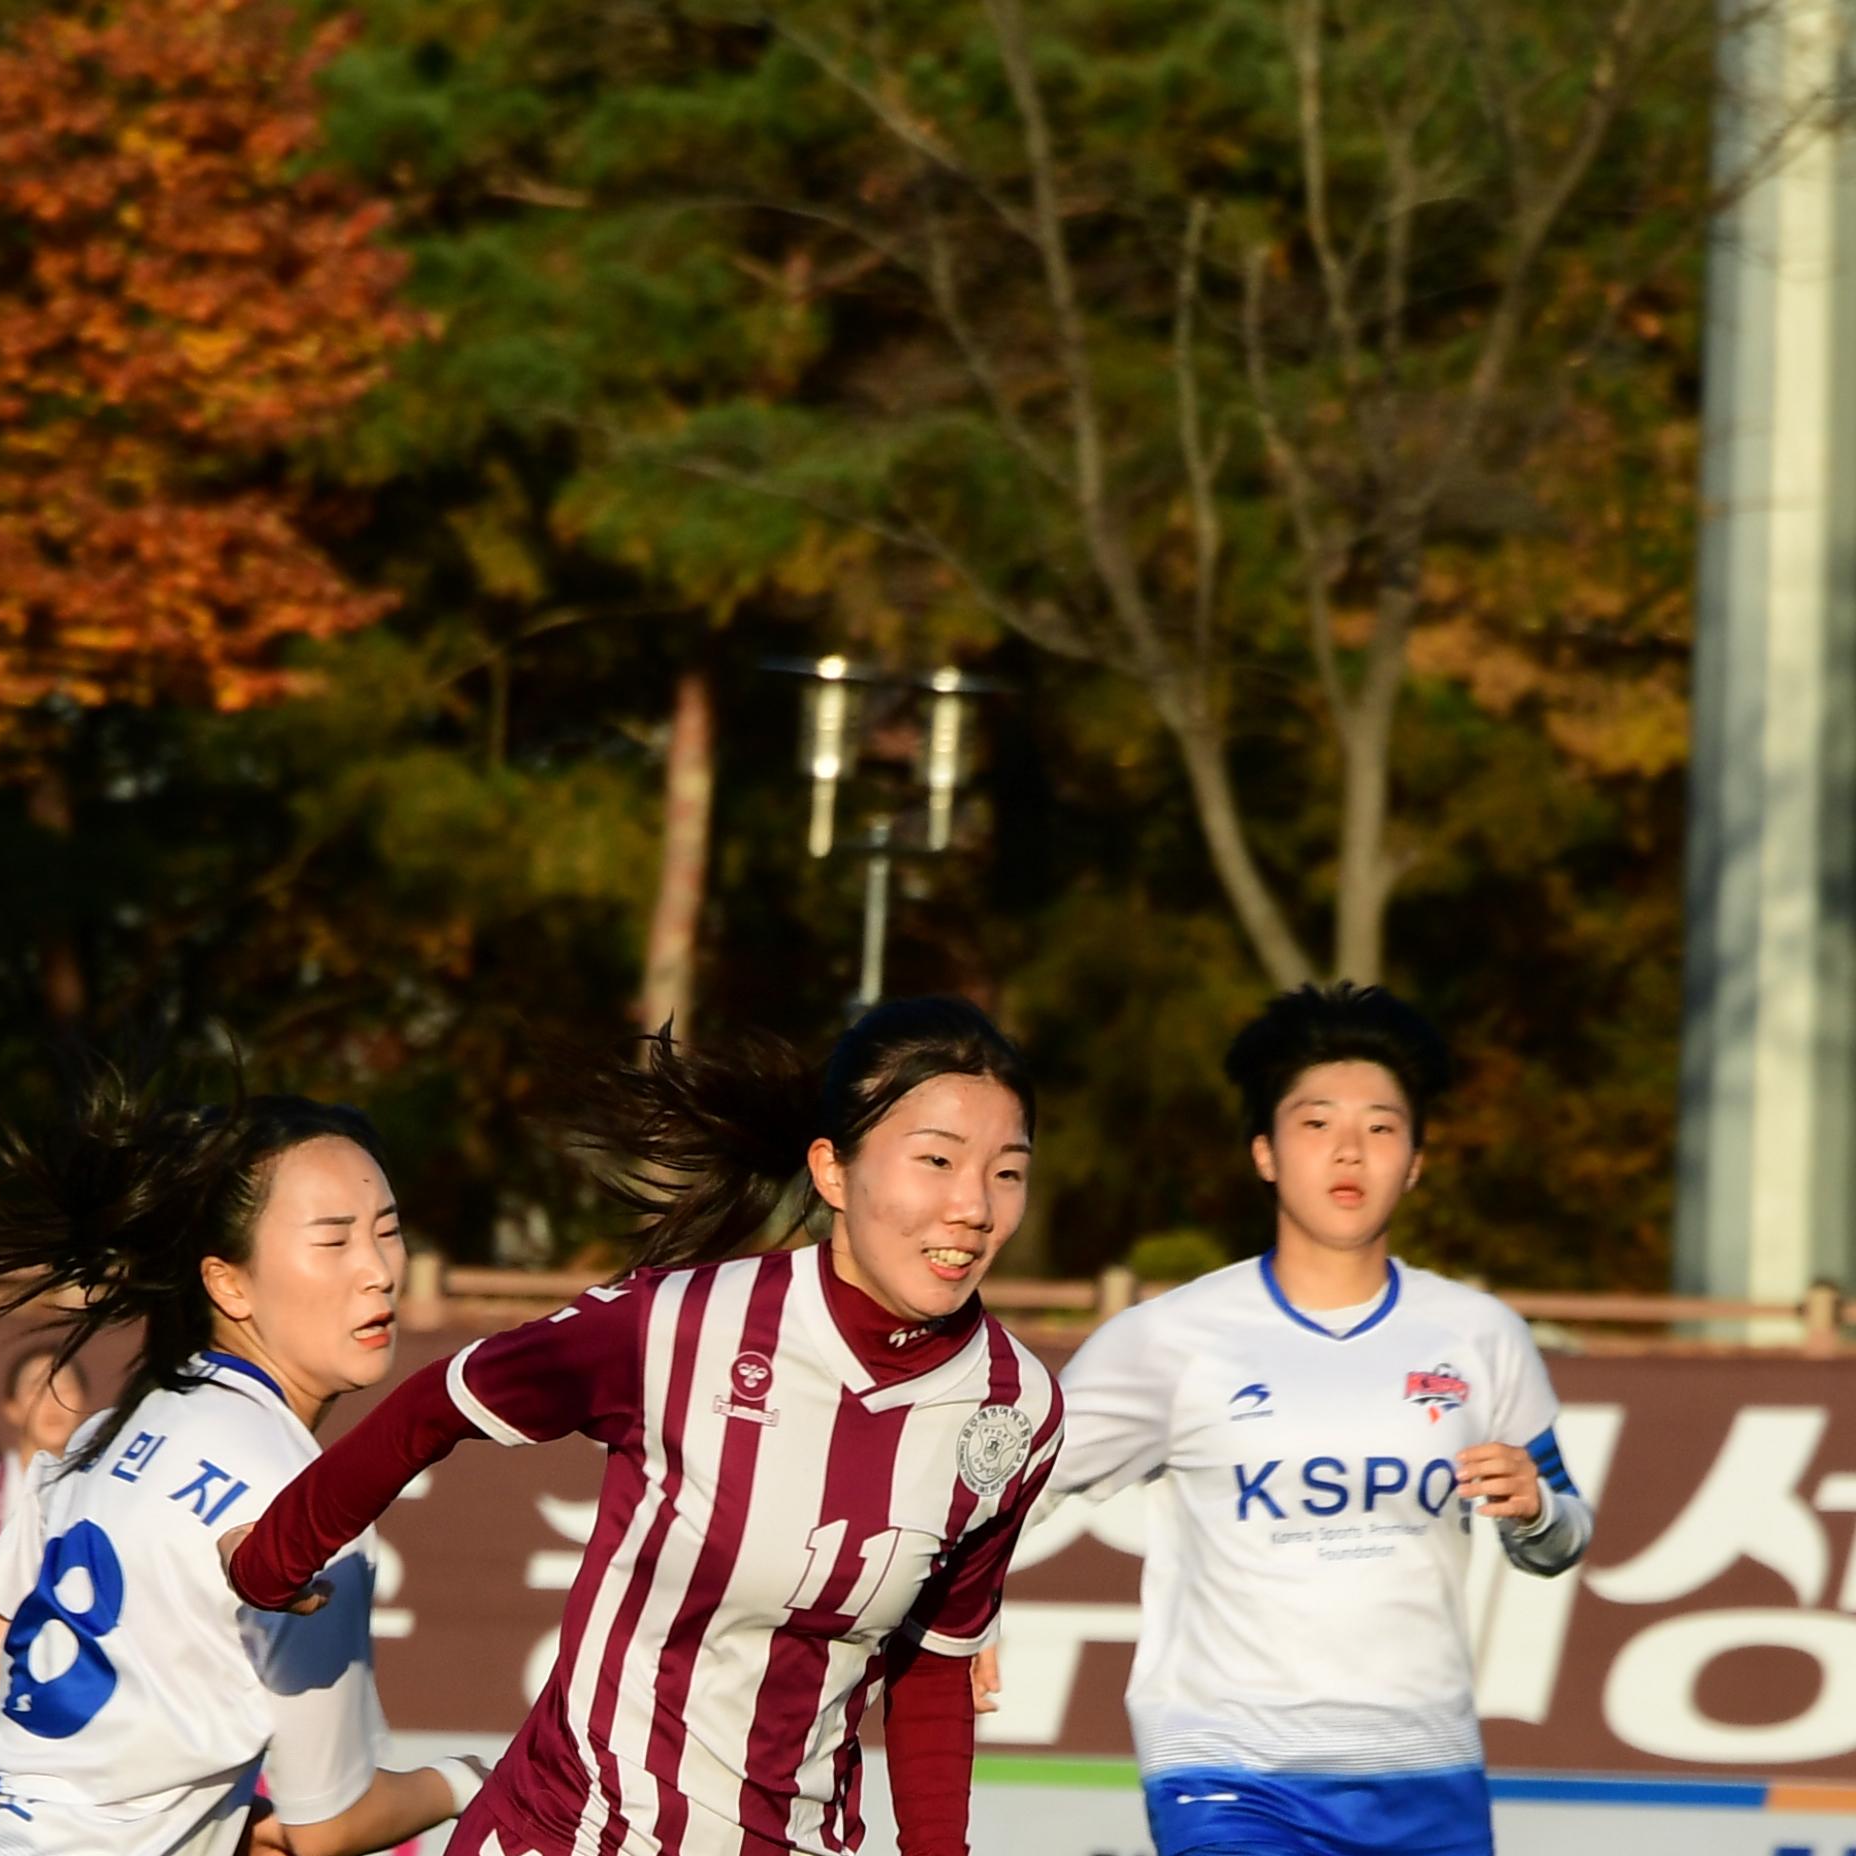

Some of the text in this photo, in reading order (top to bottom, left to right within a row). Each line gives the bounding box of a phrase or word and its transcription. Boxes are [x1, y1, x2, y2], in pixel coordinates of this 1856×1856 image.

[1234, 1456, 1459, 1522] KSPO
[784, 1519, 902, 1617] 11
[3, 1518, 124, 1740] 8
